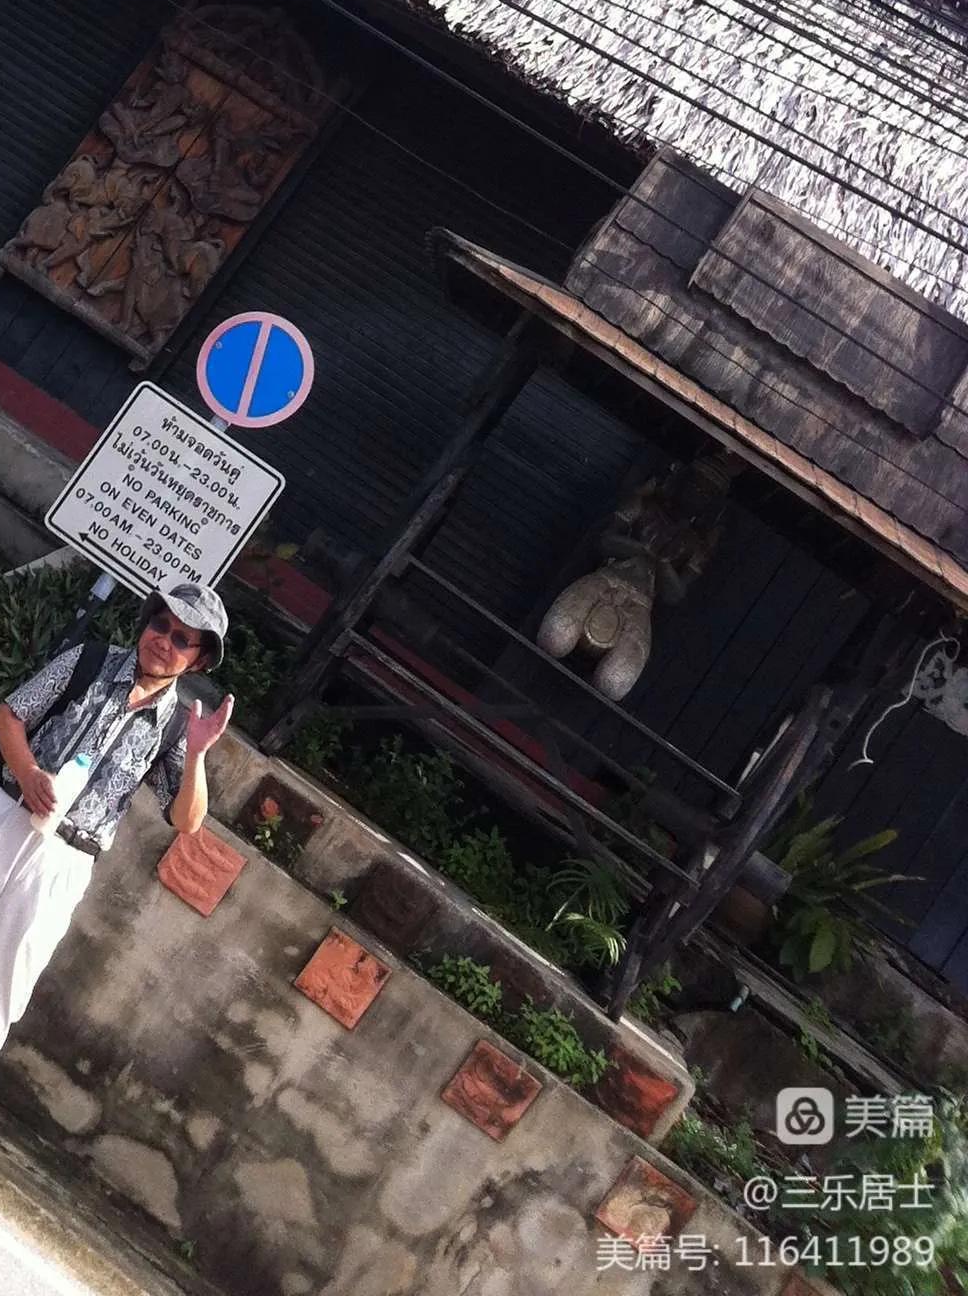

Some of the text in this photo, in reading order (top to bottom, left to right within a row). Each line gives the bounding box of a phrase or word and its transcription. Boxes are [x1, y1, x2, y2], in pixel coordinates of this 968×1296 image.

[100, 481, 203, 561] ON EVEN DATES
[122, 473, 202, 536] NO PARKING
[88, 521, 169, 583] NO HOLIDAY
